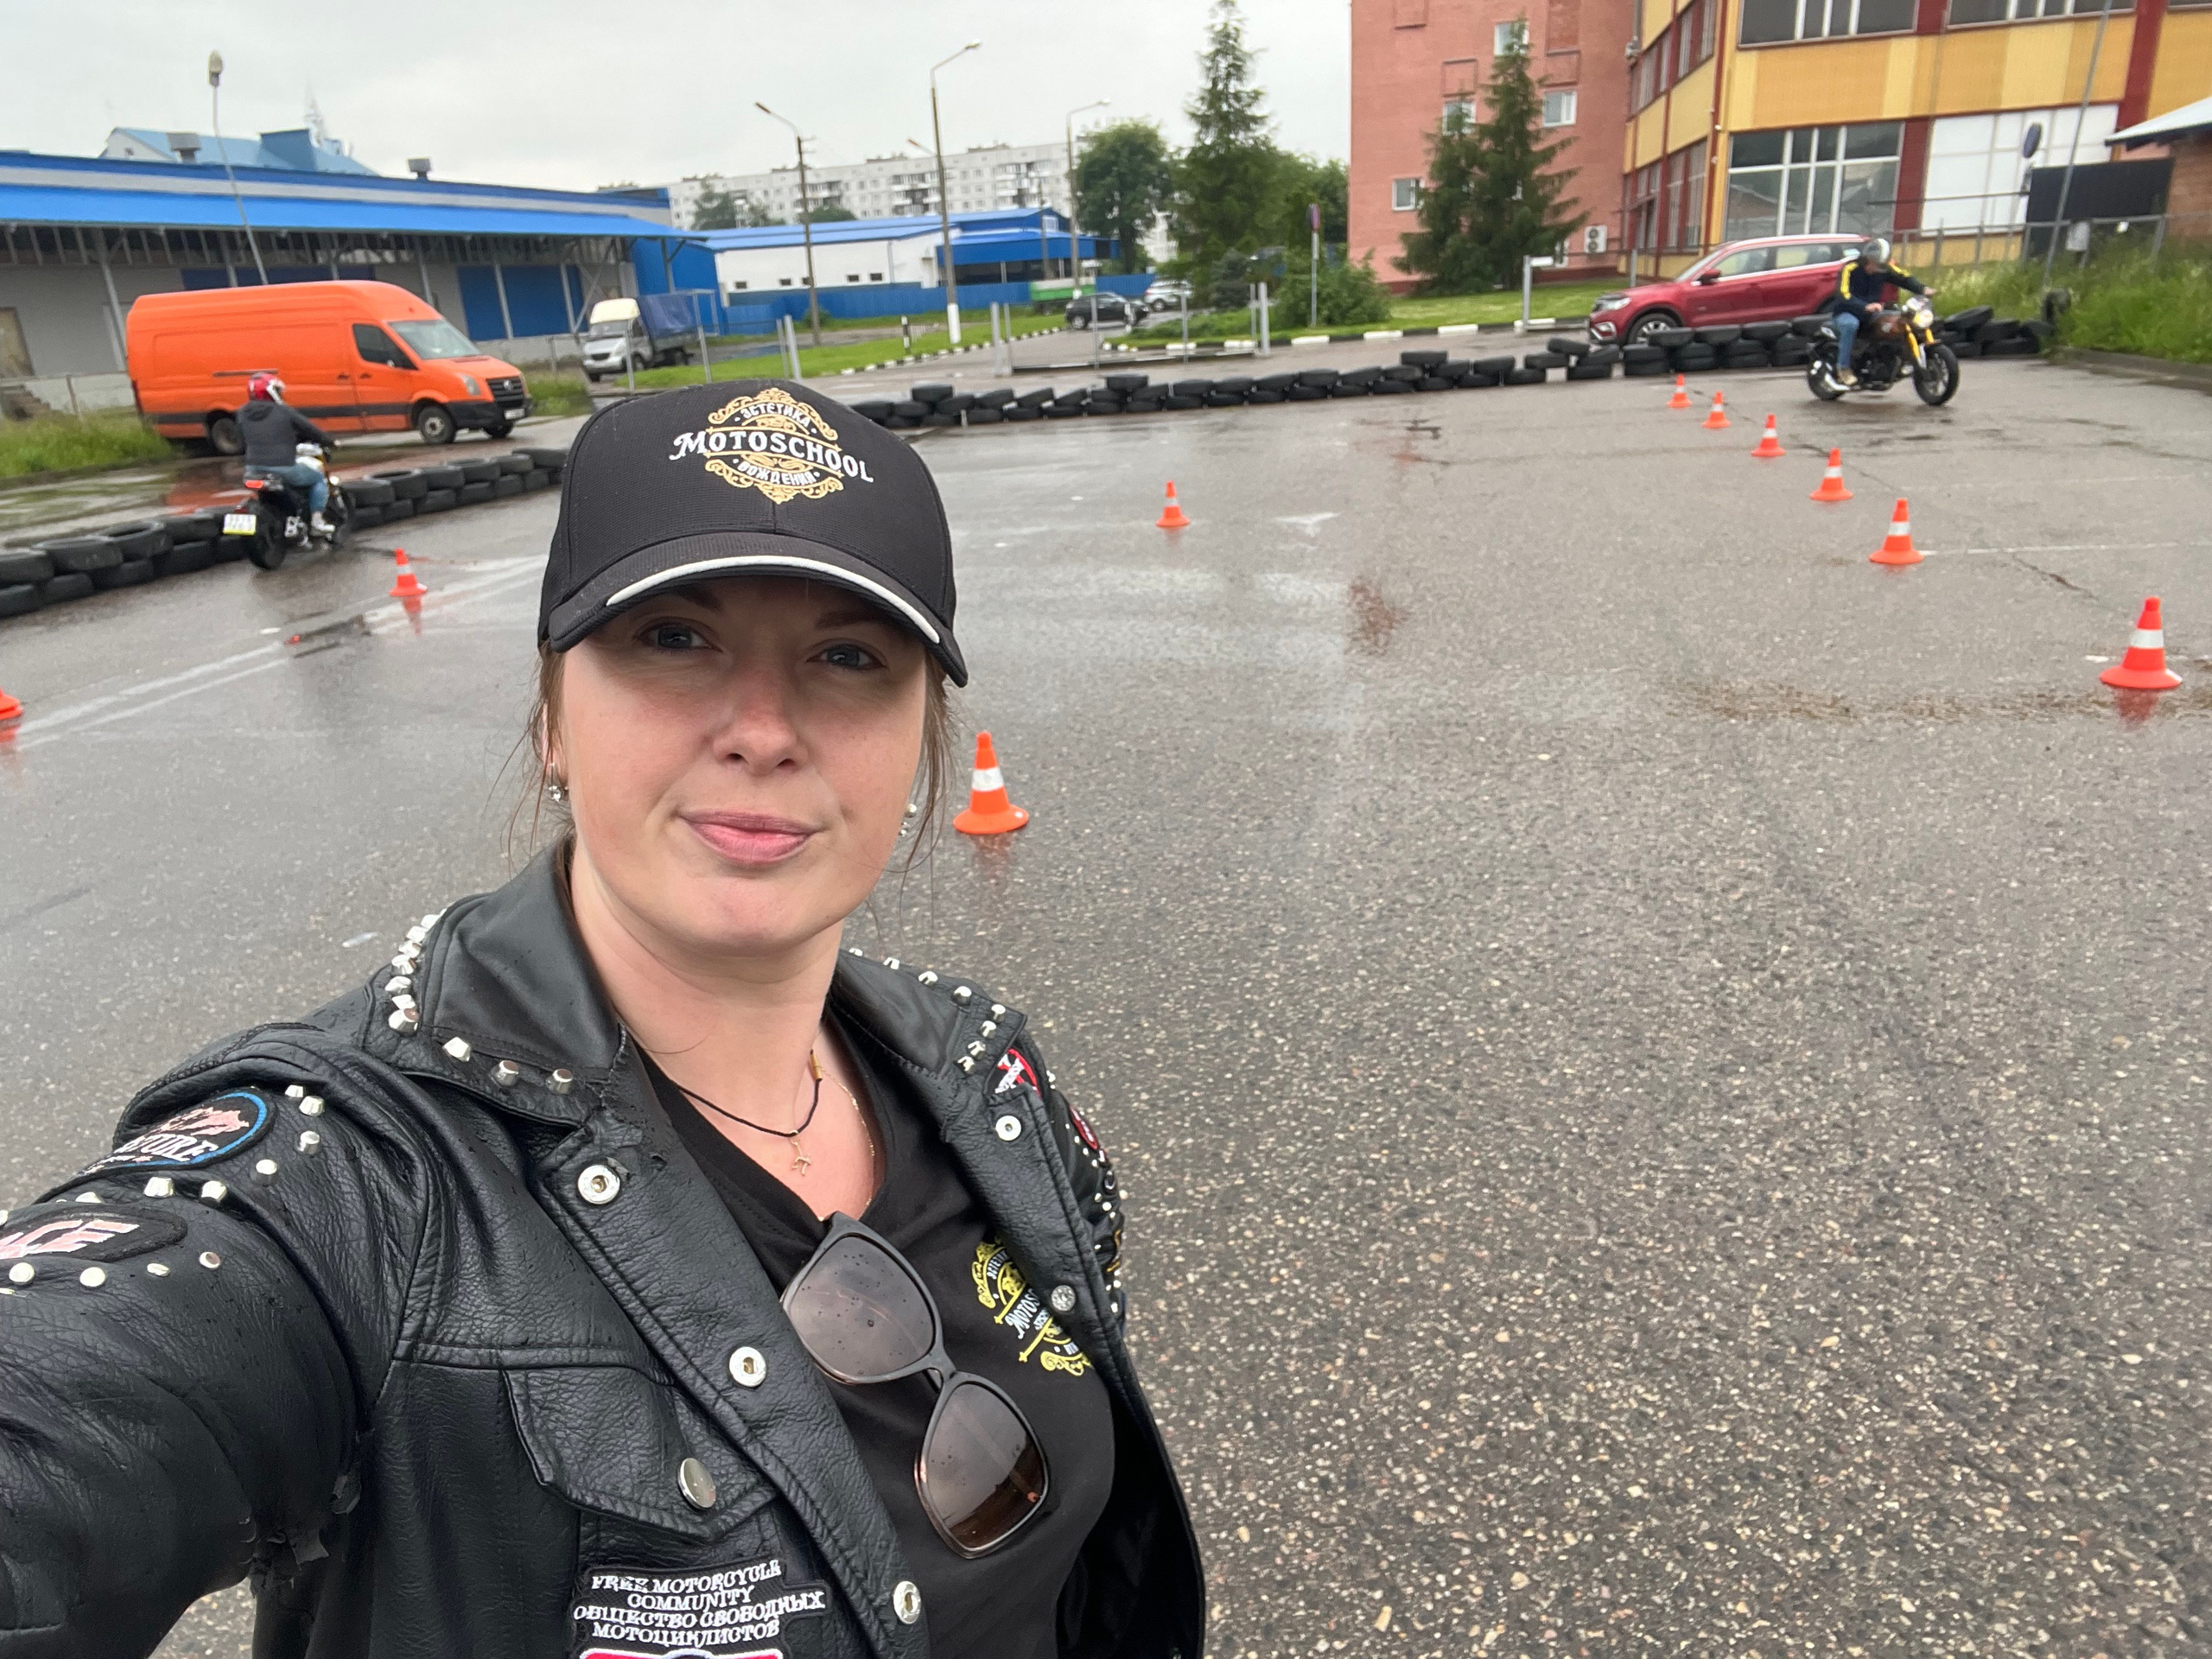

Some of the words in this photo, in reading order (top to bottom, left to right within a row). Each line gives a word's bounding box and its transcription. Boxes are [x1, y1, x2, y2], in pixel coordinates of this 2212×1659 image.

[741, 403, 810, 428] ЭСТЕТИКА
[669, 430, 874, 483] MOTOSCHOOL
[737, 460, 817, 486] ВОЖДЕНИЯ
[591, 1575, 648, 1593] FREE
[651, 1560, 782, 1594] MOTORCYCLE
[574, 1605, 697, 1629] ОБЩЕСТВО
[700, 1591, 826, 1628] СВОБОДНЫХ
[627, 1586, 755, 1612] COMMUNITY
[592, 1621, 780, 1648] МОТОЦИКЛИСТОВ
